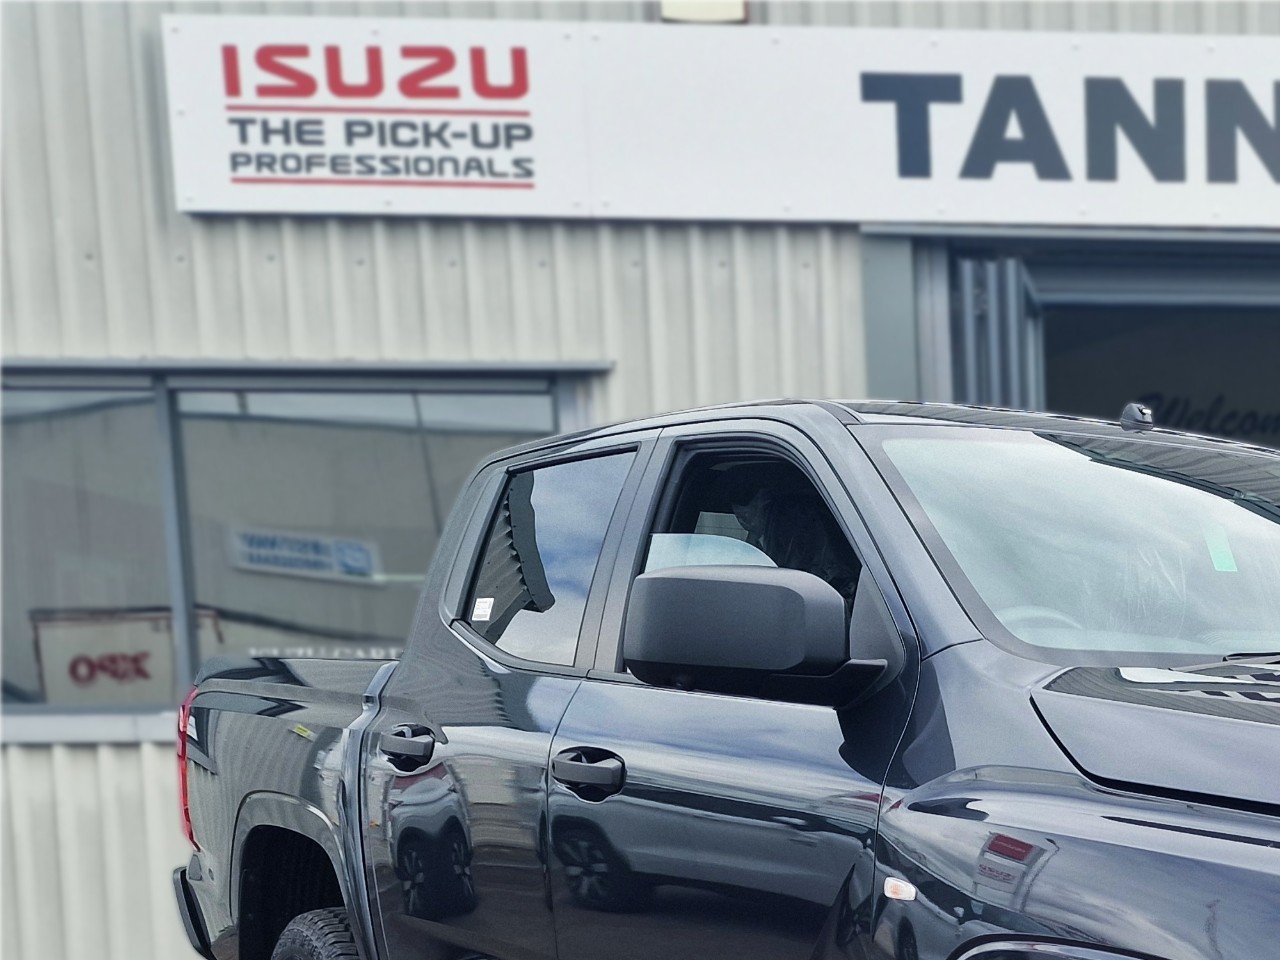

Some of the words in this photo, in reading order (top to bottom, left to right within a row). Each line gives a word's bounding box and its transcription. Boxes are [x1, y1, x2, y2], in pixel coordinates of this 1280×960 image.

[221, 44, 529, 99] ISUZU
[227, 117, 325, 146] THE
[344, 119, 534, 150] PICK-UP
[229, 151, 535, 179] PROFESSIONALS
